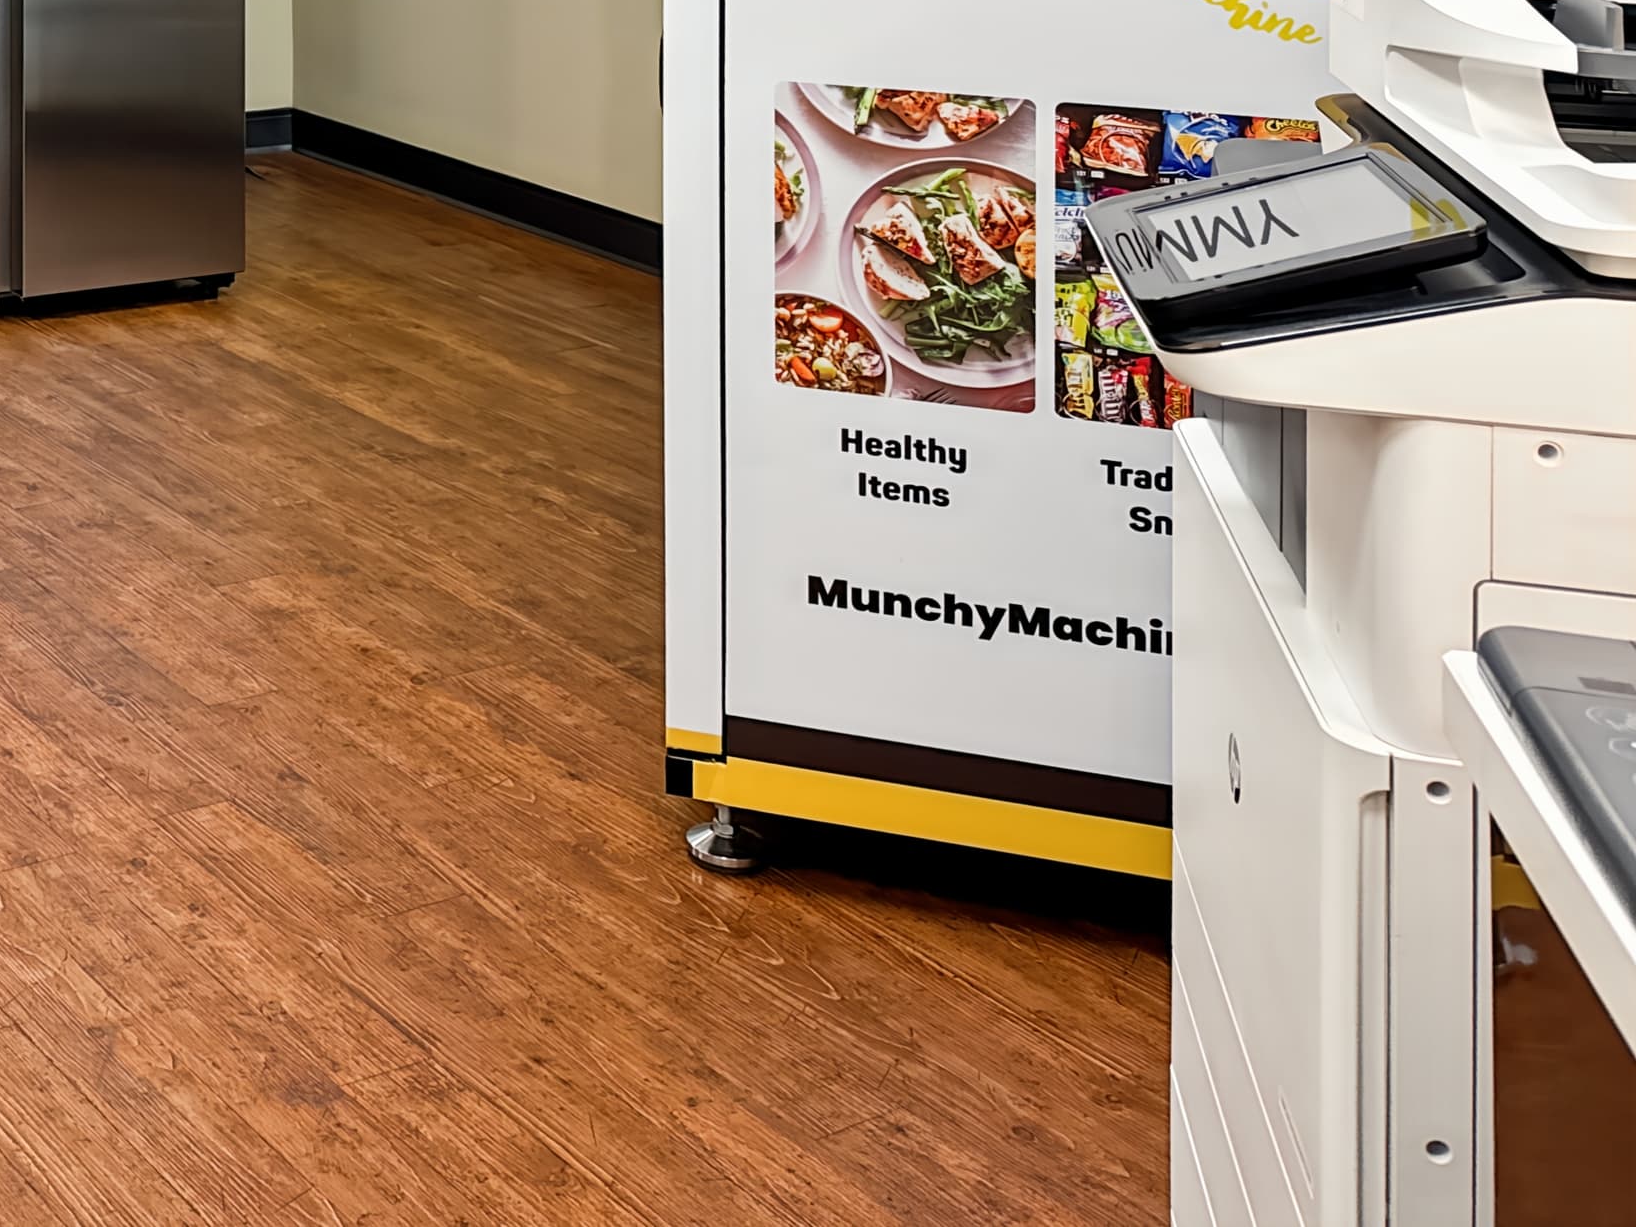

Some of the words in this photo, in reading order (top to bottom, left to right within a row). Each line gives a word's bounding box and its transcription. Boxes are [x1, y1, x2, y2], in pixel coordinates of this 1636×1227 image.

[841, 428, 968, 474] Healthy
[858, 472, 951, 507] Items
[807, 575, 1173, 656] MunchyMachi
